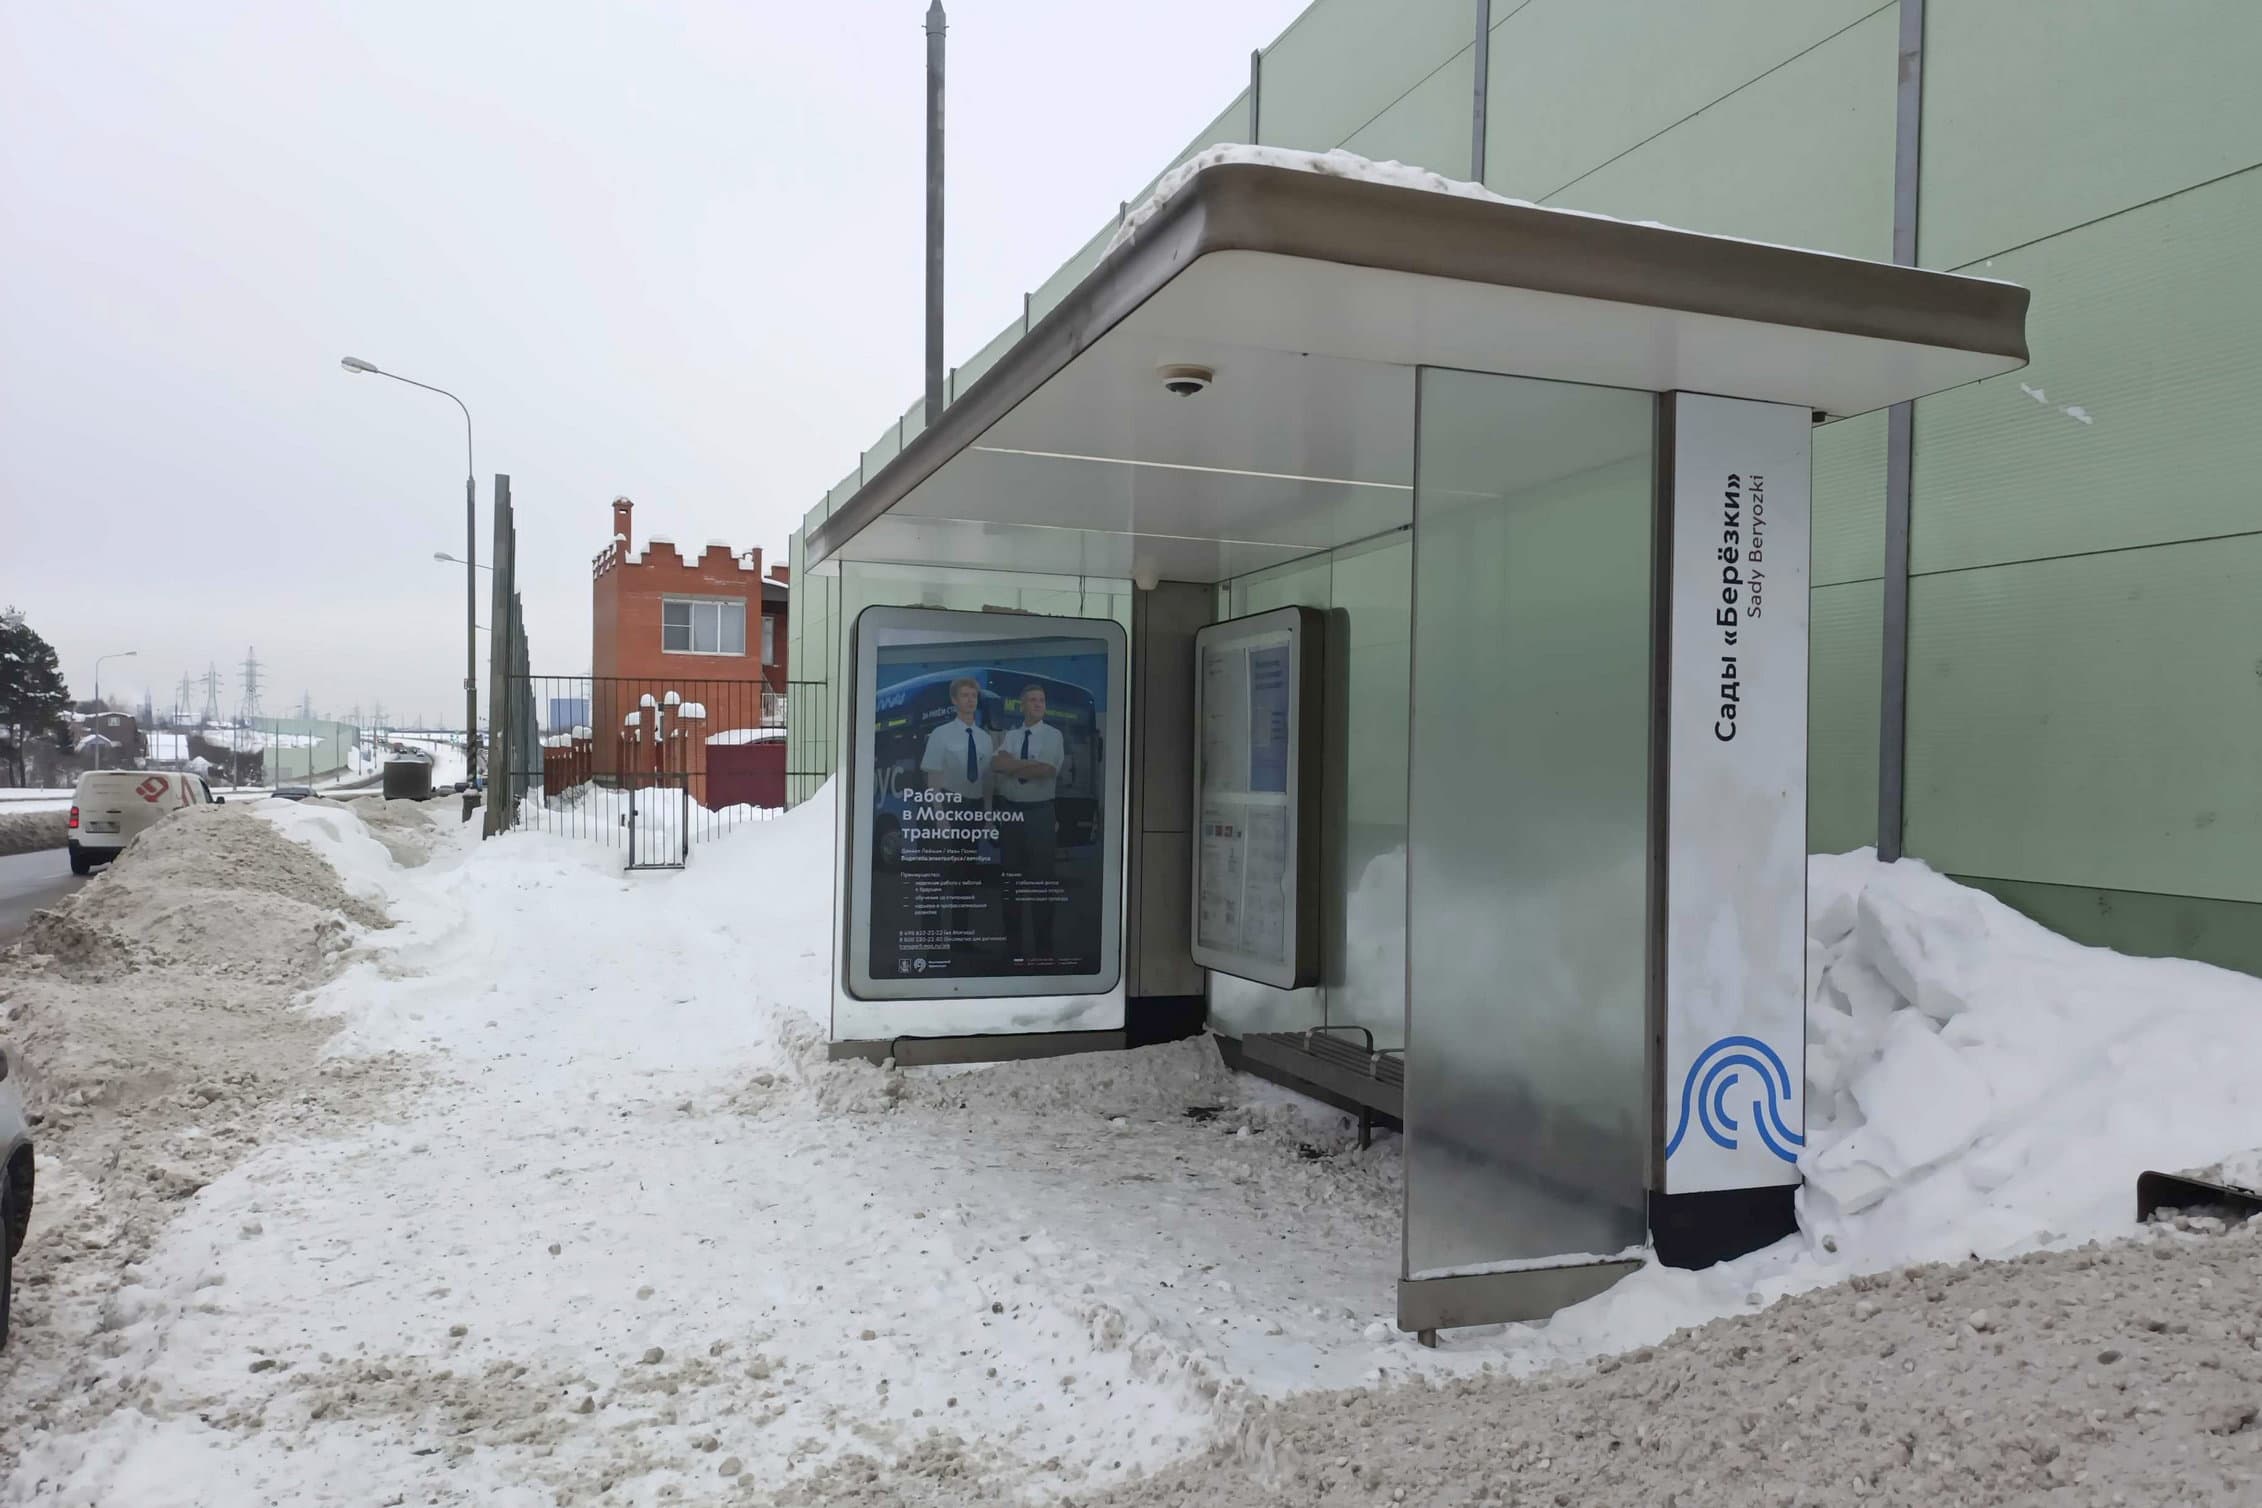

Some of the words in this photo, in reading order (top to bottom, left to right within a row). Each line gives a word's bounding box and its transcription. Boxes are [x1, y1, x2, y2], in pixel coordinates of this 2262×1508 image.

[1748, 475, 1767, 562] Beryozki
[1716, 473, 1743, 646] «Берёзки»
[1747, 571, 1765, 618] Sady
[1714, 656, 1740, 742] Сады
[903, 788, 962, 803] Работа
[903, 809, 911, 821] в
[916, 807, 1024, 822] Московском
[902, 827, 1000, 842] транспорте
